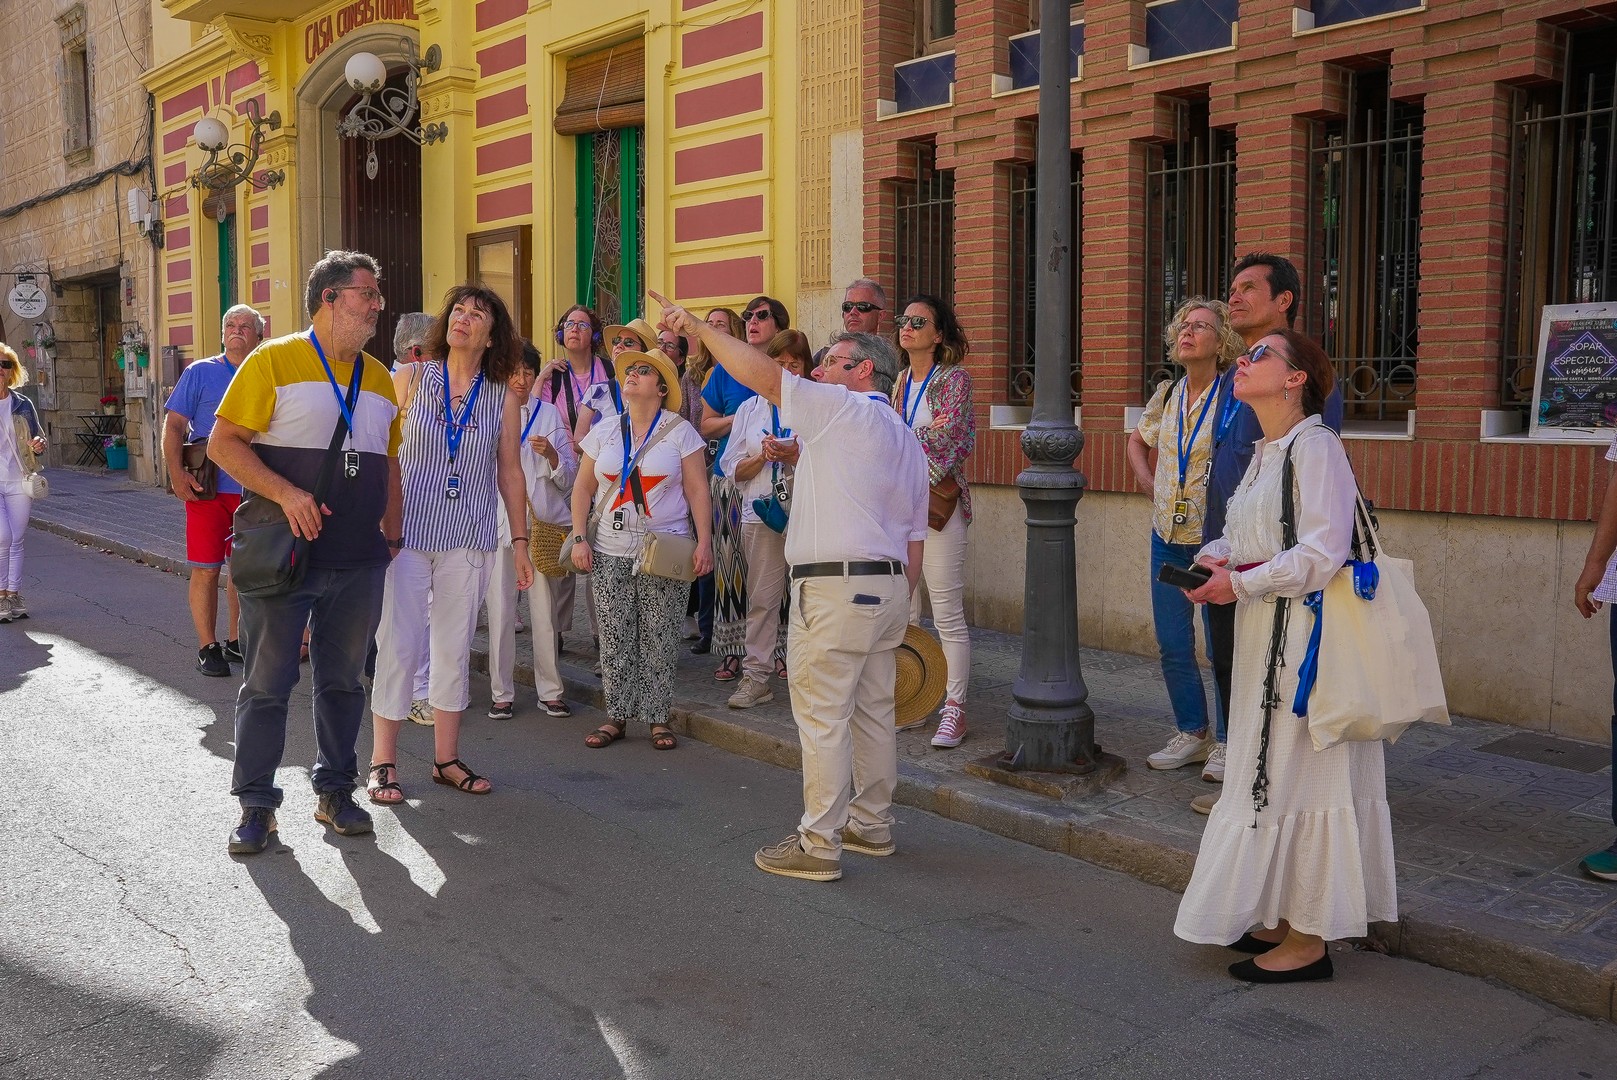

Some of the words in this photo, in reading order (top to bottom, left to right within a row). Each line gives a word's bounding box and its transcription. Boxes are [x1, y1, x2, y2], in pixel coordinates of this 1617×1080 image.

[305, 15, 333, 64] CASA
[1569, 343, 1602, 351] SOPAR
[1554, 355, 1615, 365] ESPECTACLE
